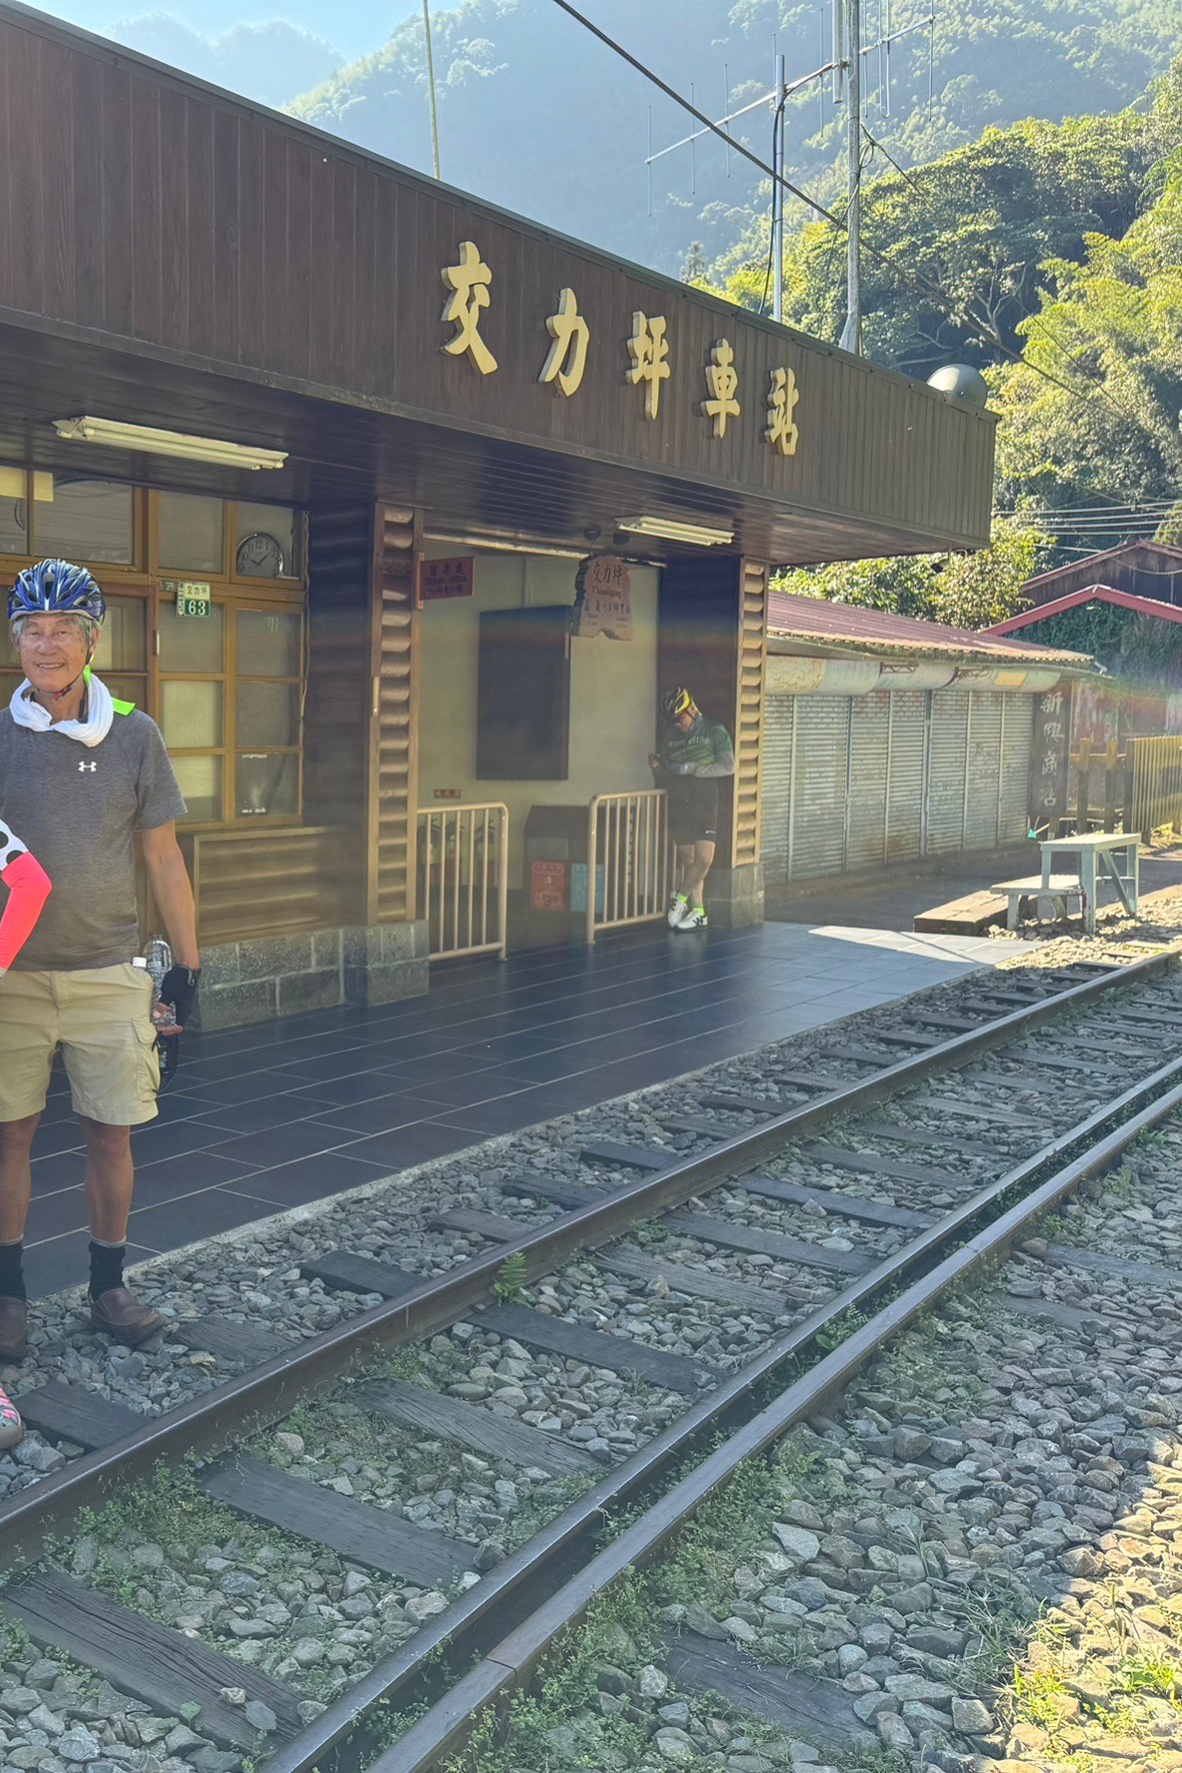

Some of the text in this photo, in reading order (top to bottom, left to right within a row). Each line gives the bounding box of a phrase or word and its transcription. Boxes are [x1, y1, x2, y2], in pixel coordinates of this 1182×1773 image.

[440, 241, 799, 456] 交力坪車站
[188, 600, 206, 616] 63
